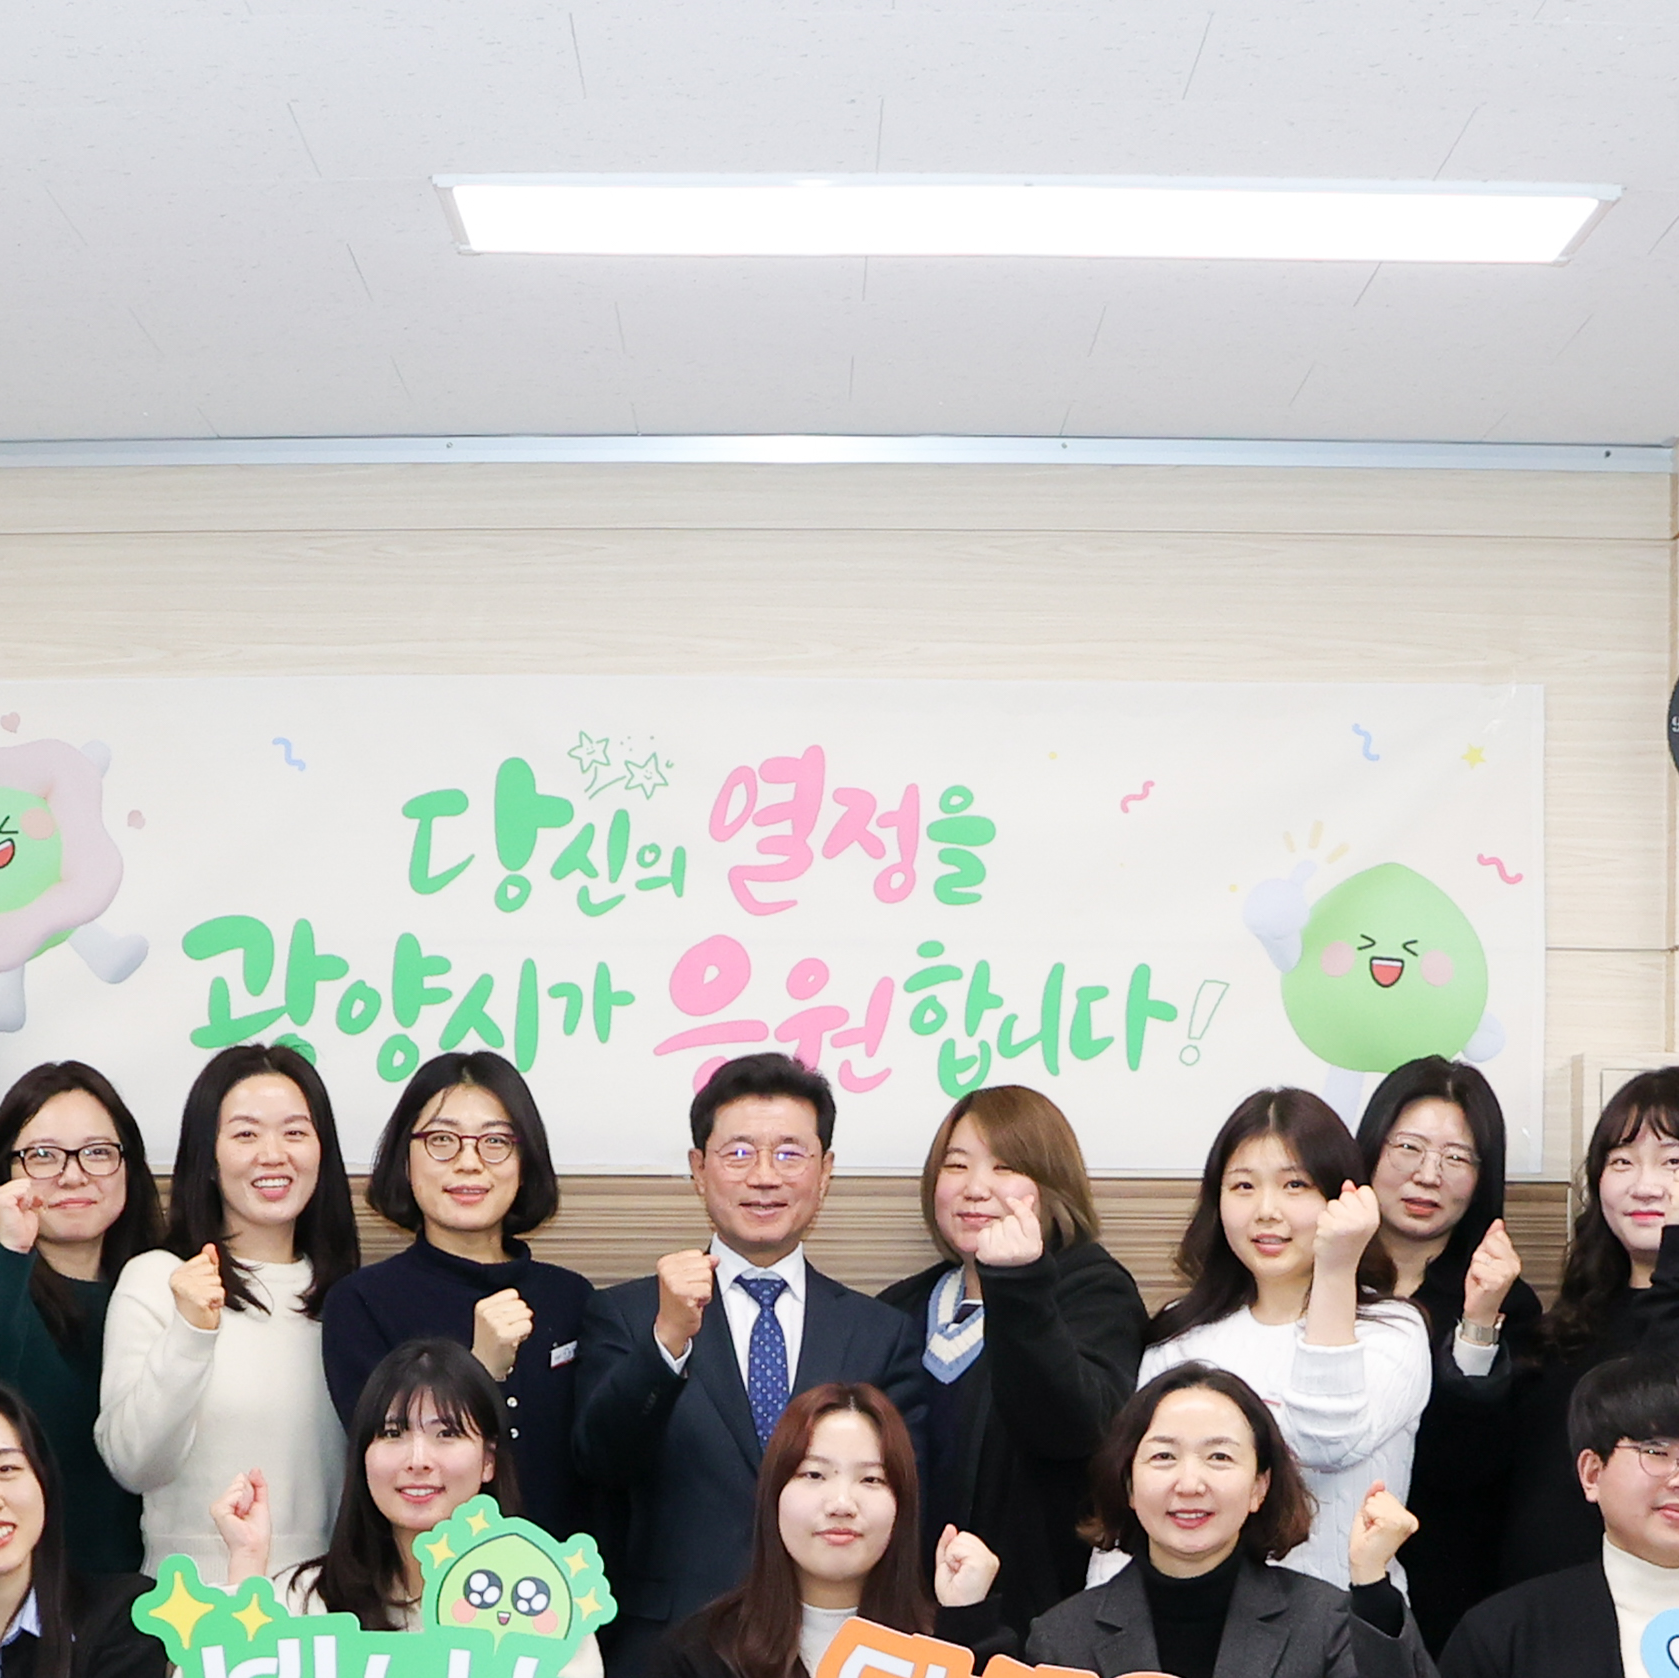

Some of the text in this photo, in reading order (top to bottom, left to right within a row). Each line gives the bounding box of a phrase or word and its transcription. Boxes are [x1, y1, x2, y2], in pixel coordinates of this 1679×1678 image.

[402, 744, 997, 917] 당신의 열정을
[182, 914, 1230, 1101] 광양시가 응원합니다!
